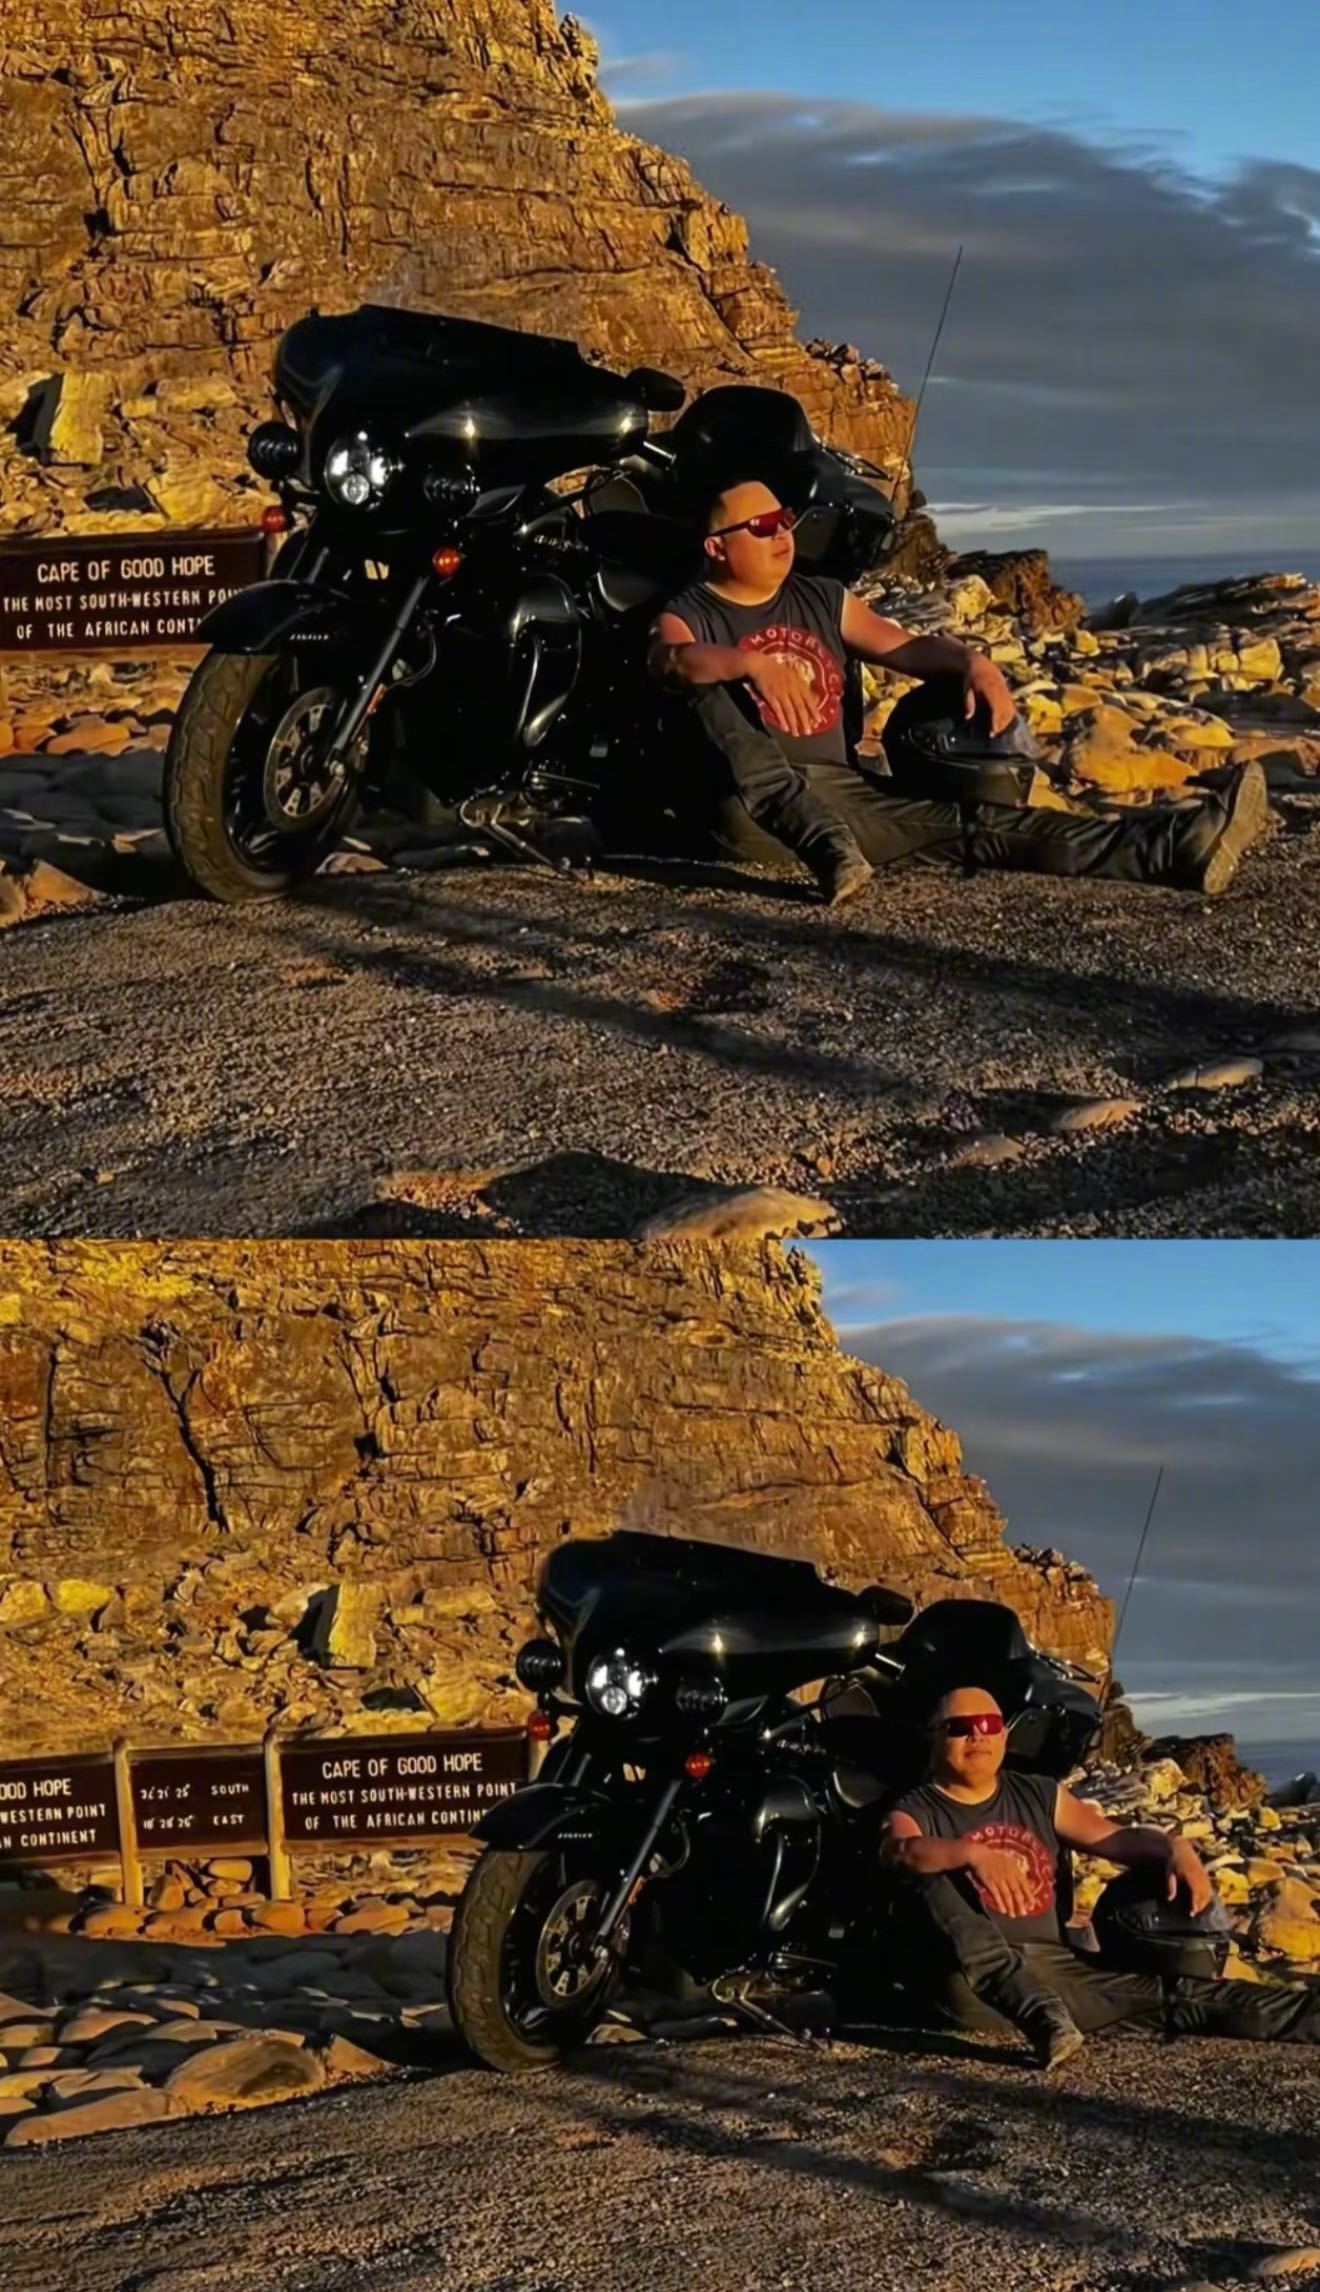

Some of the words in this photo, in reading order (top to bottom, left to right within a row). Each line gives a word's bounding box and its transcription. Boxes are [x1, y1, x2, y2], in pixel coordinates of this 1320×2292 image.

[37, 562, 79, 583] CAPE
[88, 560, 110, 580] OF
[121, 558, 164, 579] GOOD
[172, 555, 214, 576] HOPE
[4, 597, 28, 612] THE
[35, 596, 71, 611] MOST
[80, 590, 200, 610] SOUTH-WESTERN
[17, 624, 32, 639] OF
[48, 623, 73, 637] THE
[85, 621, 149, 636] AFRICAN
[322, 1760, 360, 1779] CAPE
[368, 1758, 388, 1776] OF
[397, 1755, 436, 1775] GOOD
[444, 1753, 482, 1772] HOPE
[0, 1782, 27, 1800] OOD
[33, 1778, 71, 1797] HOPE
[211, 1784, 249, 1795] SOUTH
[293, 1792, 314, 1805] THE
[321, 1790, 354, 1804] MOST
[361, 1785, 470, 1803] SOUTH-WESTERN
[477, 1782, 516, 1797] POINT
[67, 1804, 105, 1818] POINT
[213, 1814, 243, 1825] EAST
[305, 1816, 318, 1830] OF
[333, 1815, 356, 1828] THE
[367, 1812, 424, 1827] AFRICAN
[21, 1829, 95, 1847] CONTINENT
